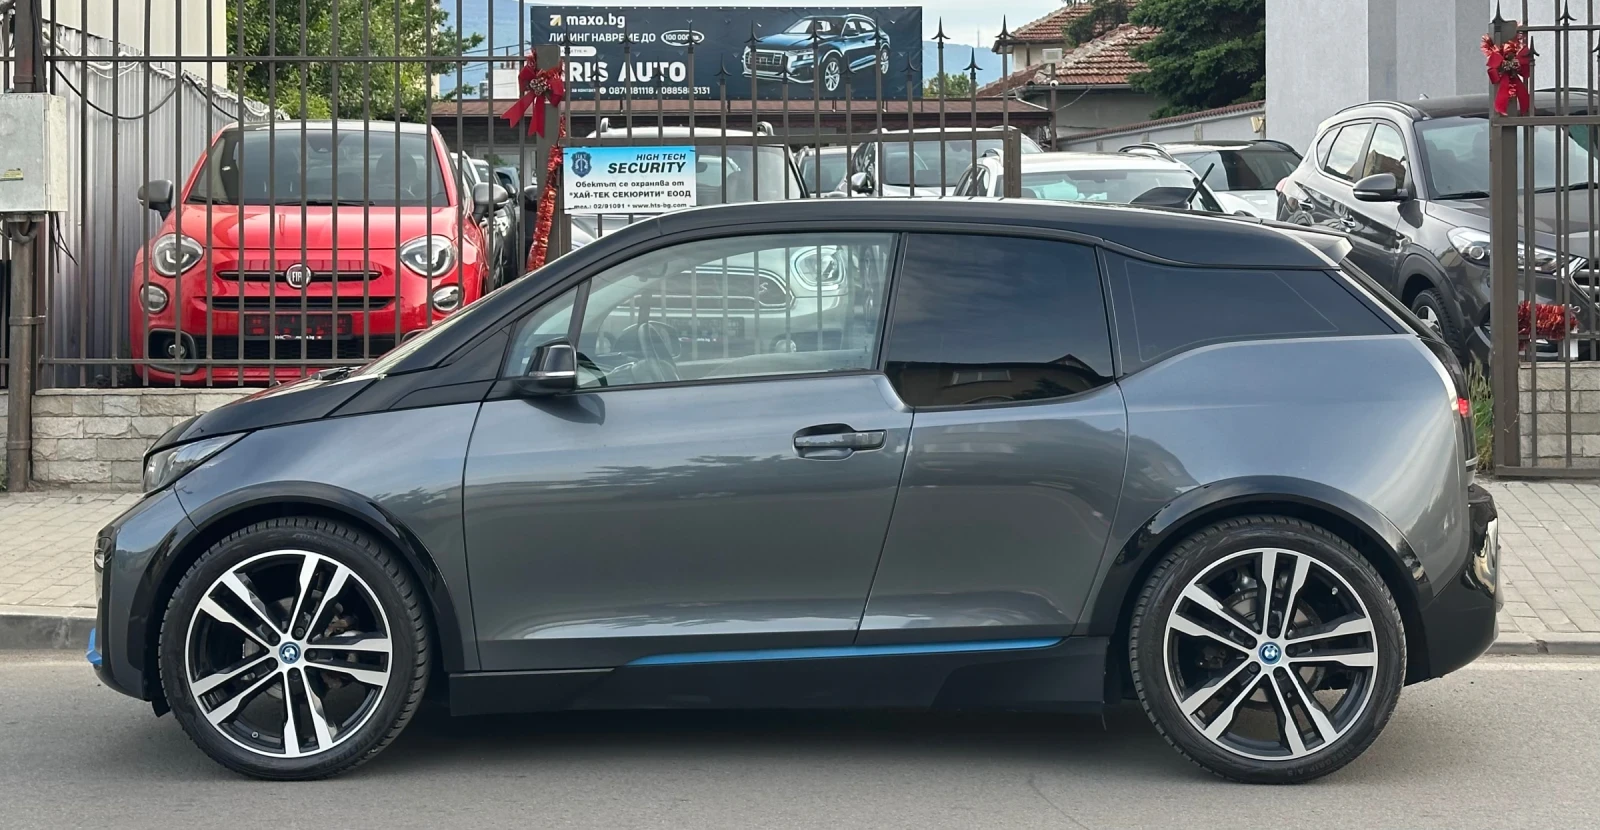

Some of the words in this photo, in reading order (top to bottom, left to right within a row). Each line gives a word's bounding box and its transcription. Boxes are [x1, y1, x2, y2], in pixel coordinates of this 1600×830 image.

[566, 13, 626, 28] maxo.bg
[549, 33, 590, 42] ЛИИНГ
[641, 33, 656, 43] ДО
[617, 61, 687, 82] AUTO
[608, 86, 654, 95] 087181118
[636, 153, 661, 161] HIGH
[607, 161, 687, 174] SECURITY
[631, 180, 670, 188] охранява
[667, 190, 692, 198] ЕООД
